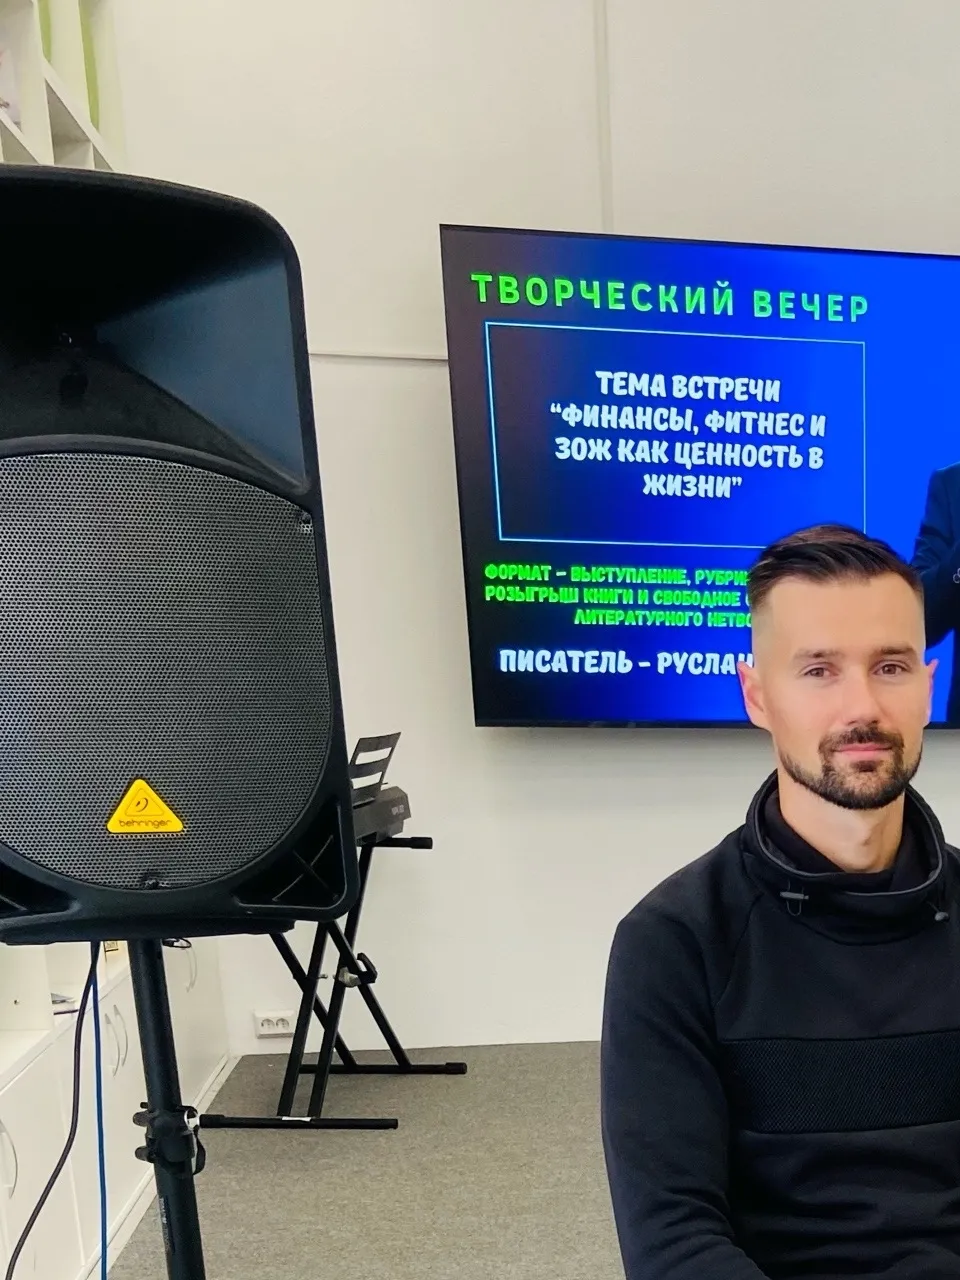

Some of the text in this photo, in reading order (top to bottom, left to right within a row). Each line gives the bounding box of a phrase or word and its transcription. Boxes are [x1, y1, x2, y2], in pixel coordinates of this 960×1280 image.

[471, 273, 869, 323] ТВОРЧЕСКИЙ ВЕЧЕР
[595, 370, 781, 403] ТЕМА ВСТРЕЧИ
[704, 410, 804, 437] ФИТНЕС
[809, 415, 826, 438] И
[554, 436, 824, 471] ЗОЖ КАК ЦЕННОСТЬ В
[484, 564, 552, 581] ФОРМАТ
[571, 566, 691, 586] ВЫСТУПЛЕНИЕ,
[485, 586, 579, 603] РОЗЫГРЫШ
[583, 588, 634, 605] КНИГИ
[638, 589, 649, 605] И
[653, 590, 741, 608] СВОБОДНОЕ
[574, 609, 703, 627] ЛИТЕРАТУРНОГО
[500, 650, 633, 673] ПИСАТЕЛЬ
[119, 819, 172, 829] behringer
